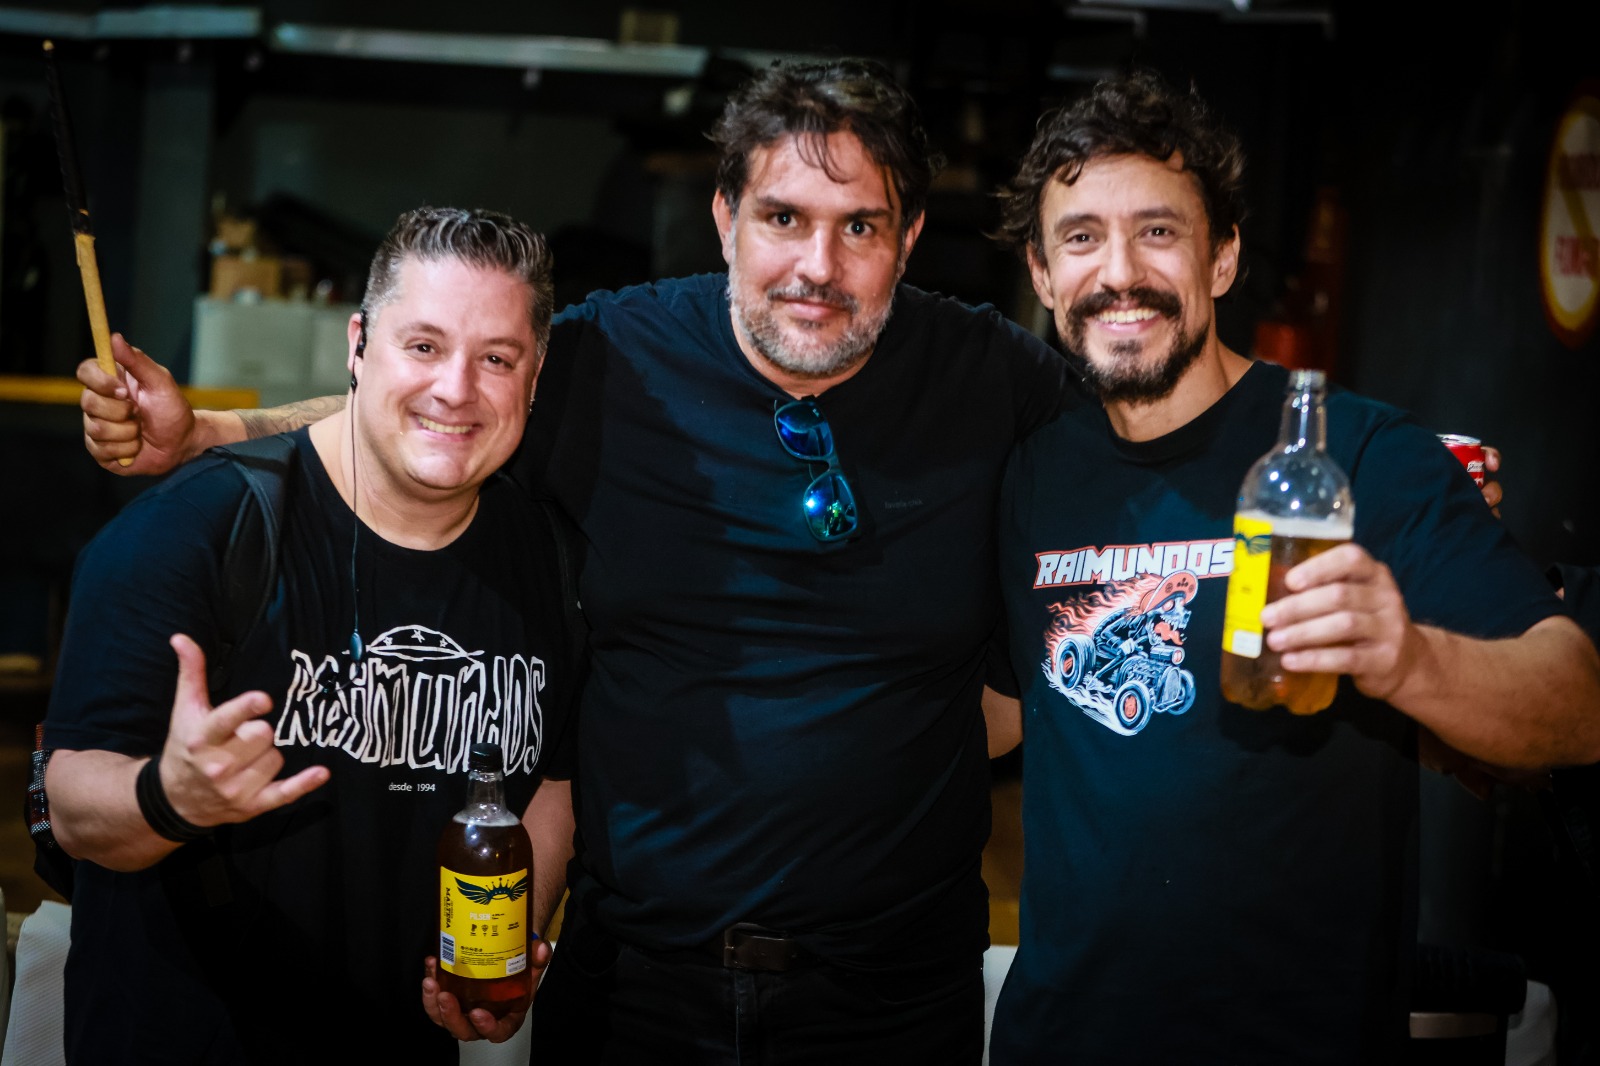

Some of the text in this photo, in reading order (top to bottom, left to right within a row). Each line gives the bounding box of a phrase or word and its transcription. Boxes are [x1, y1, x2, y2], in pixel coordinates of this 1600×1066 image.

[1034, 540, 1235, 588] RAIMUNDOS
[388, 782, 436, 792] desde 1994
[469, 912, 491, 921] PILSEN
